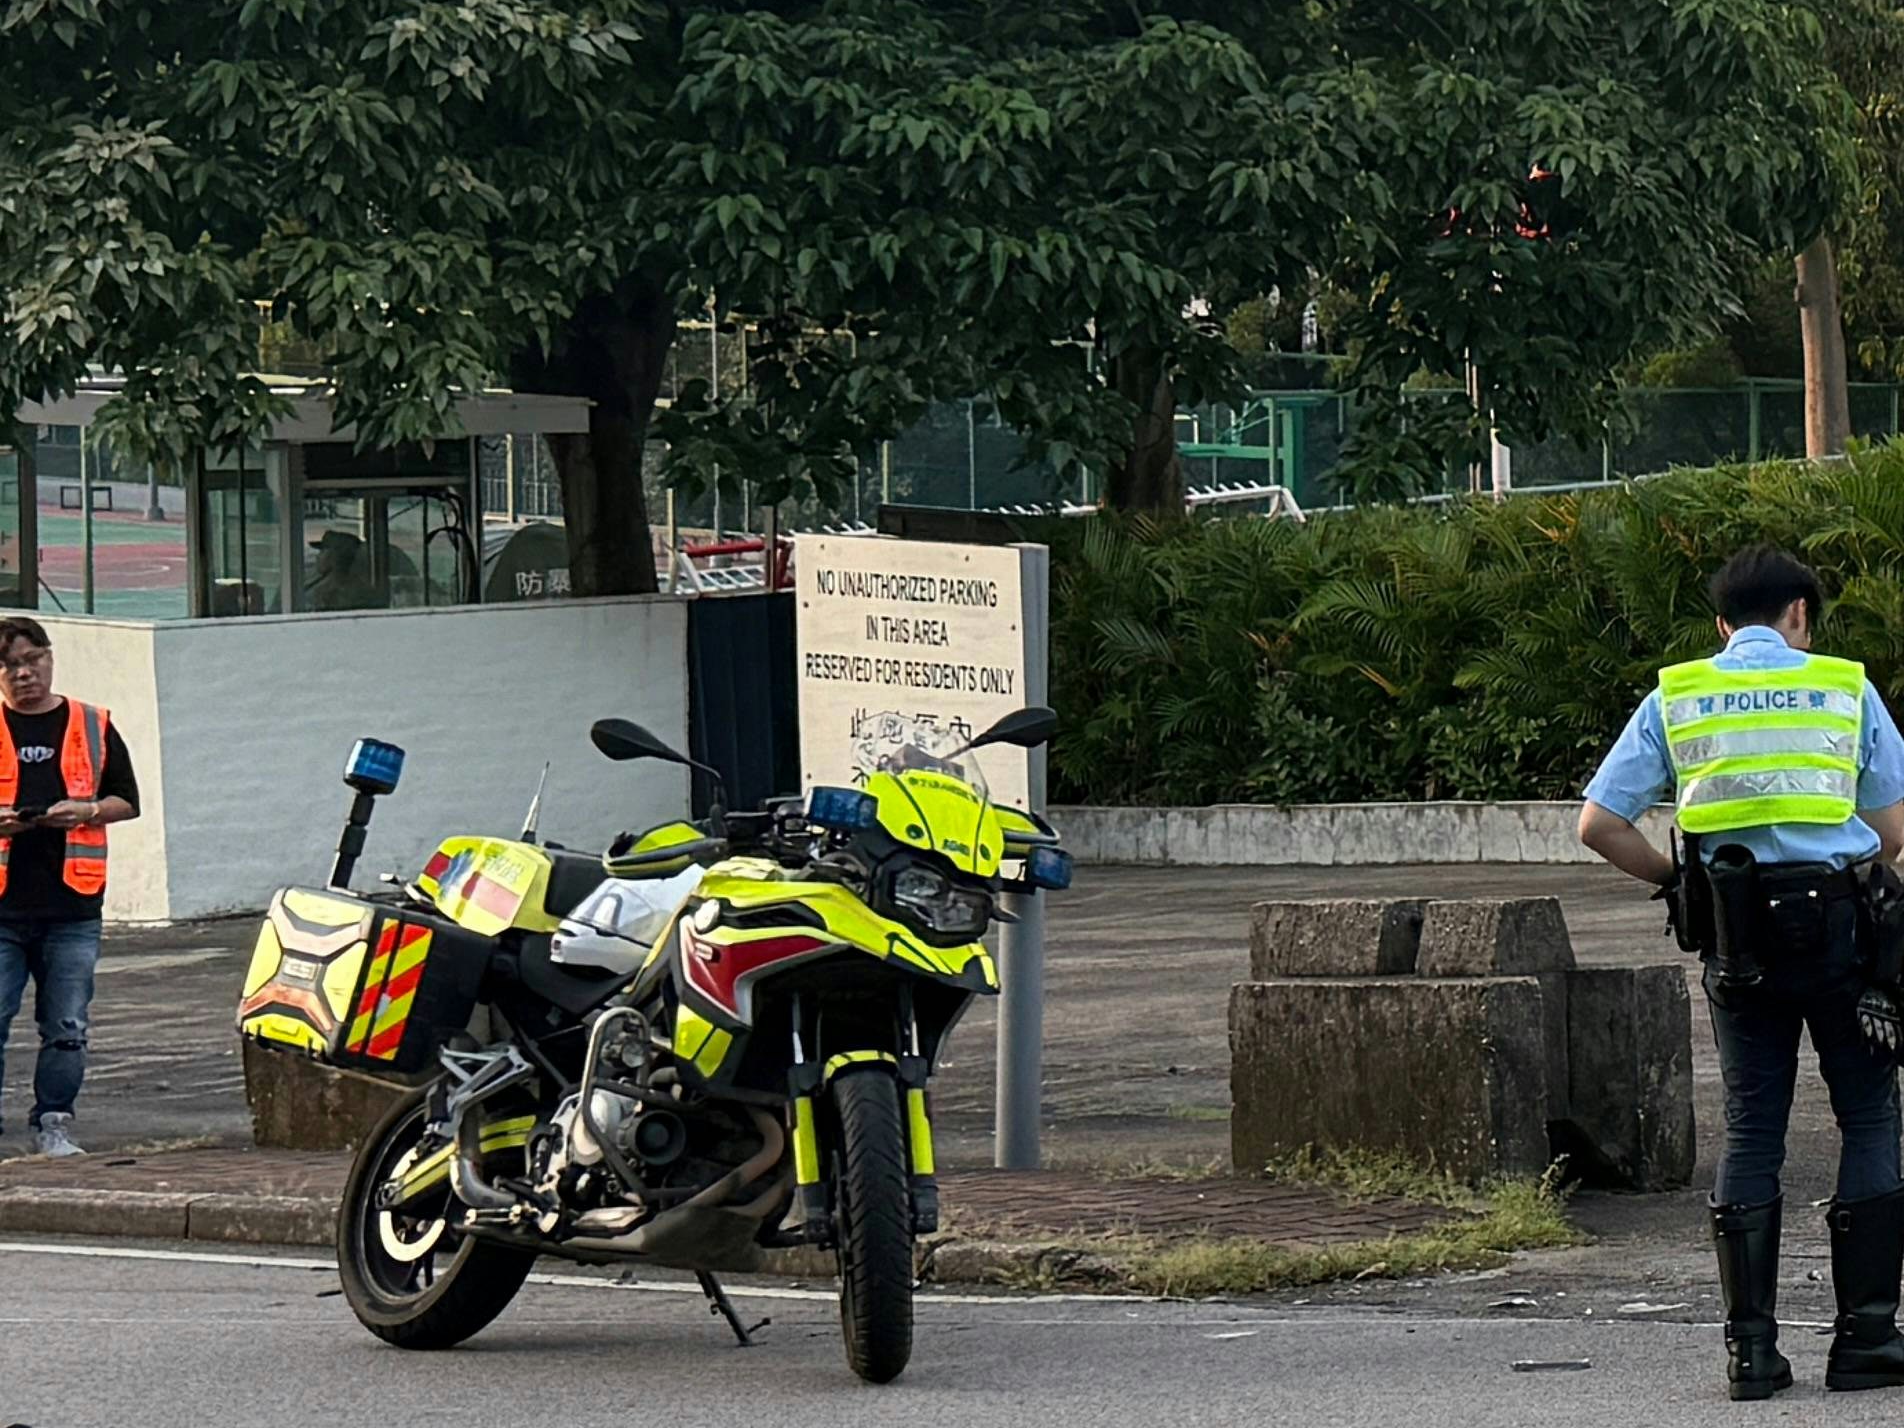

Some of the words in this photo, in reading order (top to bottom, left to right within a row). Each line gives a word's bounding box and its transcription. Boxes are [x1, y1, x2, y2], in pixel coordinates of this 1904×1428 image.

[817, 570, 835, 596] NO
[839, 571, 937, 603] UNAUTHORIZED
[940, 579, 998, 607] PARKING
[866, 615, 879, 641] IN
[881, 616, 910, 644] THIS
[913, 619, 949, 647] AREA
[805, 653, 871, 683] RESERVED
[875, 658, 901, 685] FOR
[905, 661, 978, 692] RESIDENTS
[981, 667, 1015, 695] ONLY
[1724, 690, 1799, 711] POLICE
